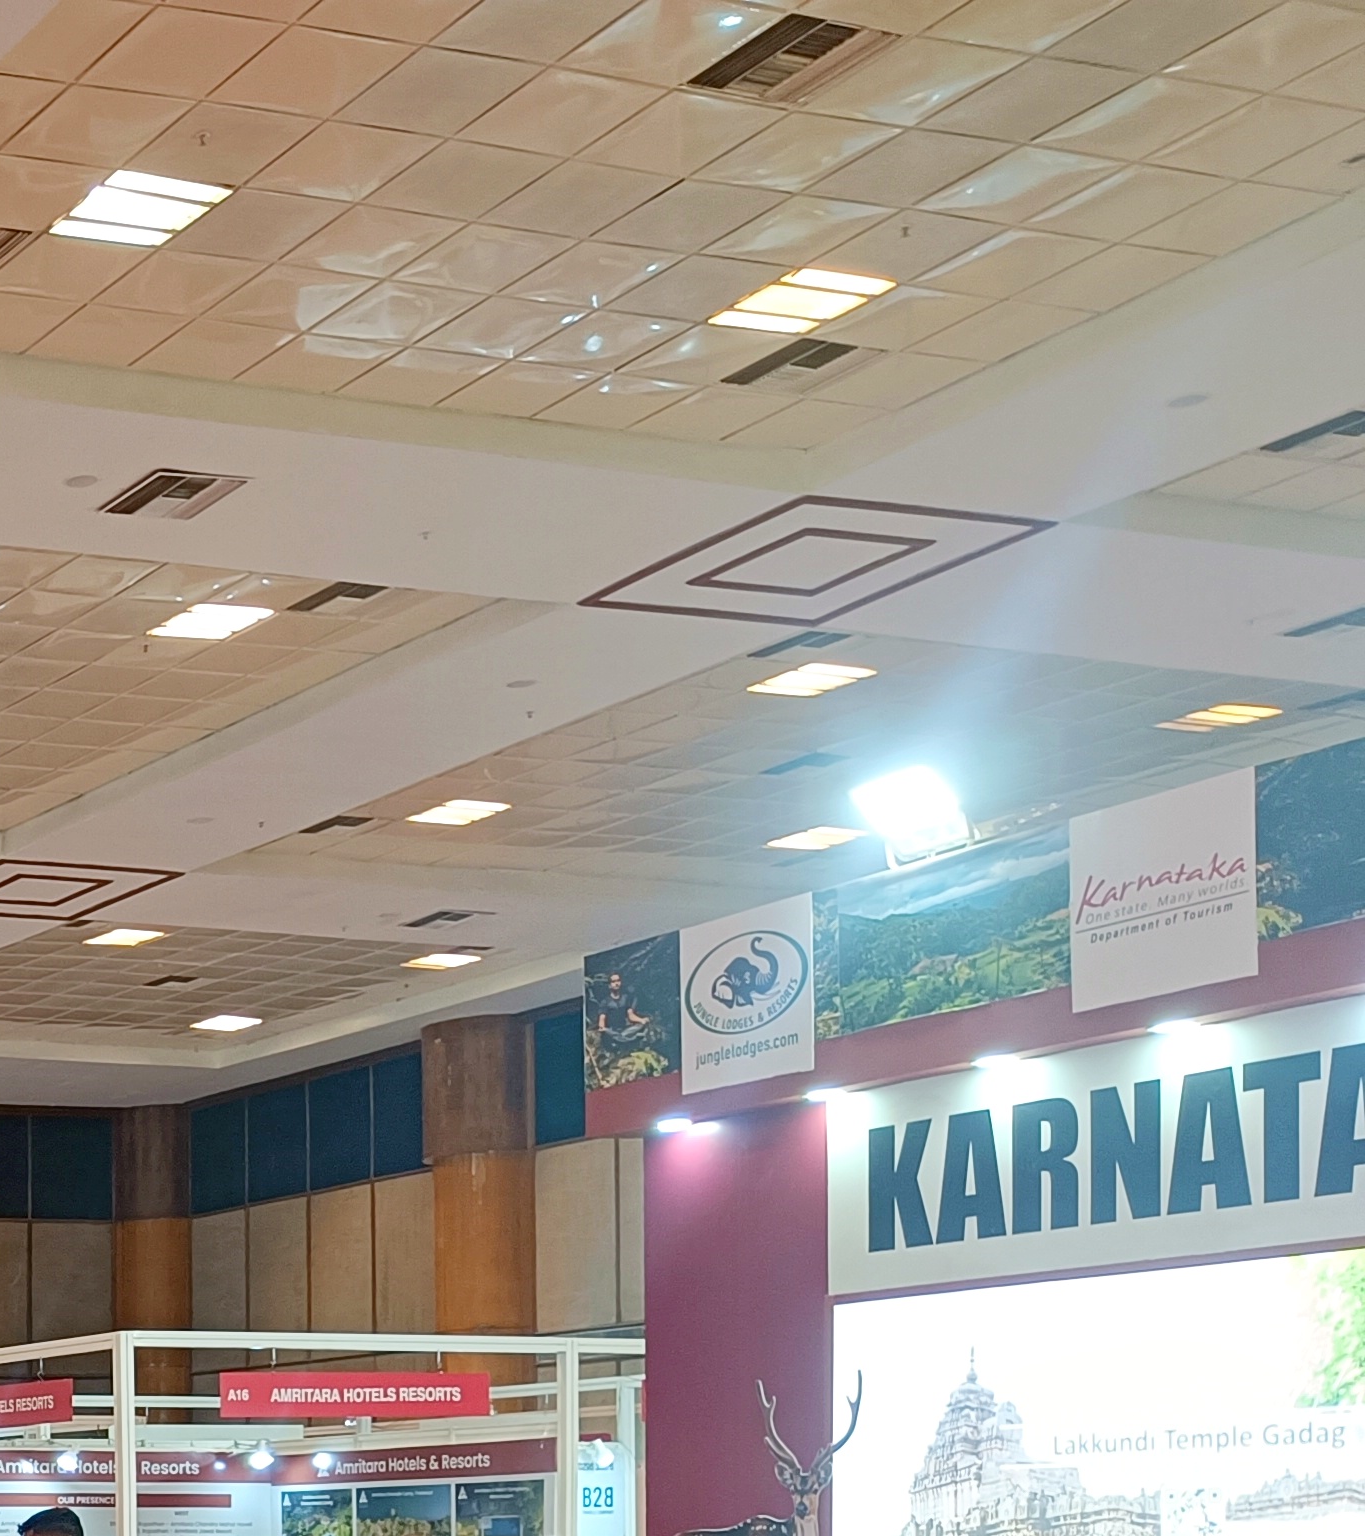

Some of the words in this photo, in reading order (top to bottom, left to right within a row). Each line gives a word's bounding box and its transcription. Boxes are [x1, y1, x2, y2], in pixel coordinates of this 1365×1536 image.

[1075, 852, 1247, 925] Karnataka
[1085, 910, 1111, 925] One
[1157, 888, 1195, 908] Many
[1090, 920, 1160, 944] Department
[1164, 912, 1178, 927] of
[1183, 901, 1233, 922] Tourism
[693, 1001, 719, 1028] JUNGLE
[721, 1016, 754, 1030] LODGES
[757, 1012, 765, 1023] &
[766, 977, 798, 1019] RESORTS
[695, 1032, 799, 1070] junglelodges.com
[869, 1043, 1365, 1253] KARNATA
[15, 1395, 55, 1411] RESORTS
[227, 1388, 250, 1401] A16
[270, 1388, 342, 1403] AMRITARA
[343, 1387, 397, 1402] HOTELS
[399, 1386, 462, 1402] RESORTS
[1053, 1430, 1156, 1456] Lakkundi
[1164, 1425, 1253, 1453] Temple
[1262, 1421, 1347, 1449] Gadag
[141, 1460, 200, 1475] Resorts
[334, 1458, 386, 1476] Amritara
[388, 1455, 426, 1472] Hotels
[428, 1455, 439, 1470] &
[441, 1452, 490, 1469] Resorts
[57, 1496, 75, 1505] OUR
[76, 1496, 115, 1505] PRESENCE
